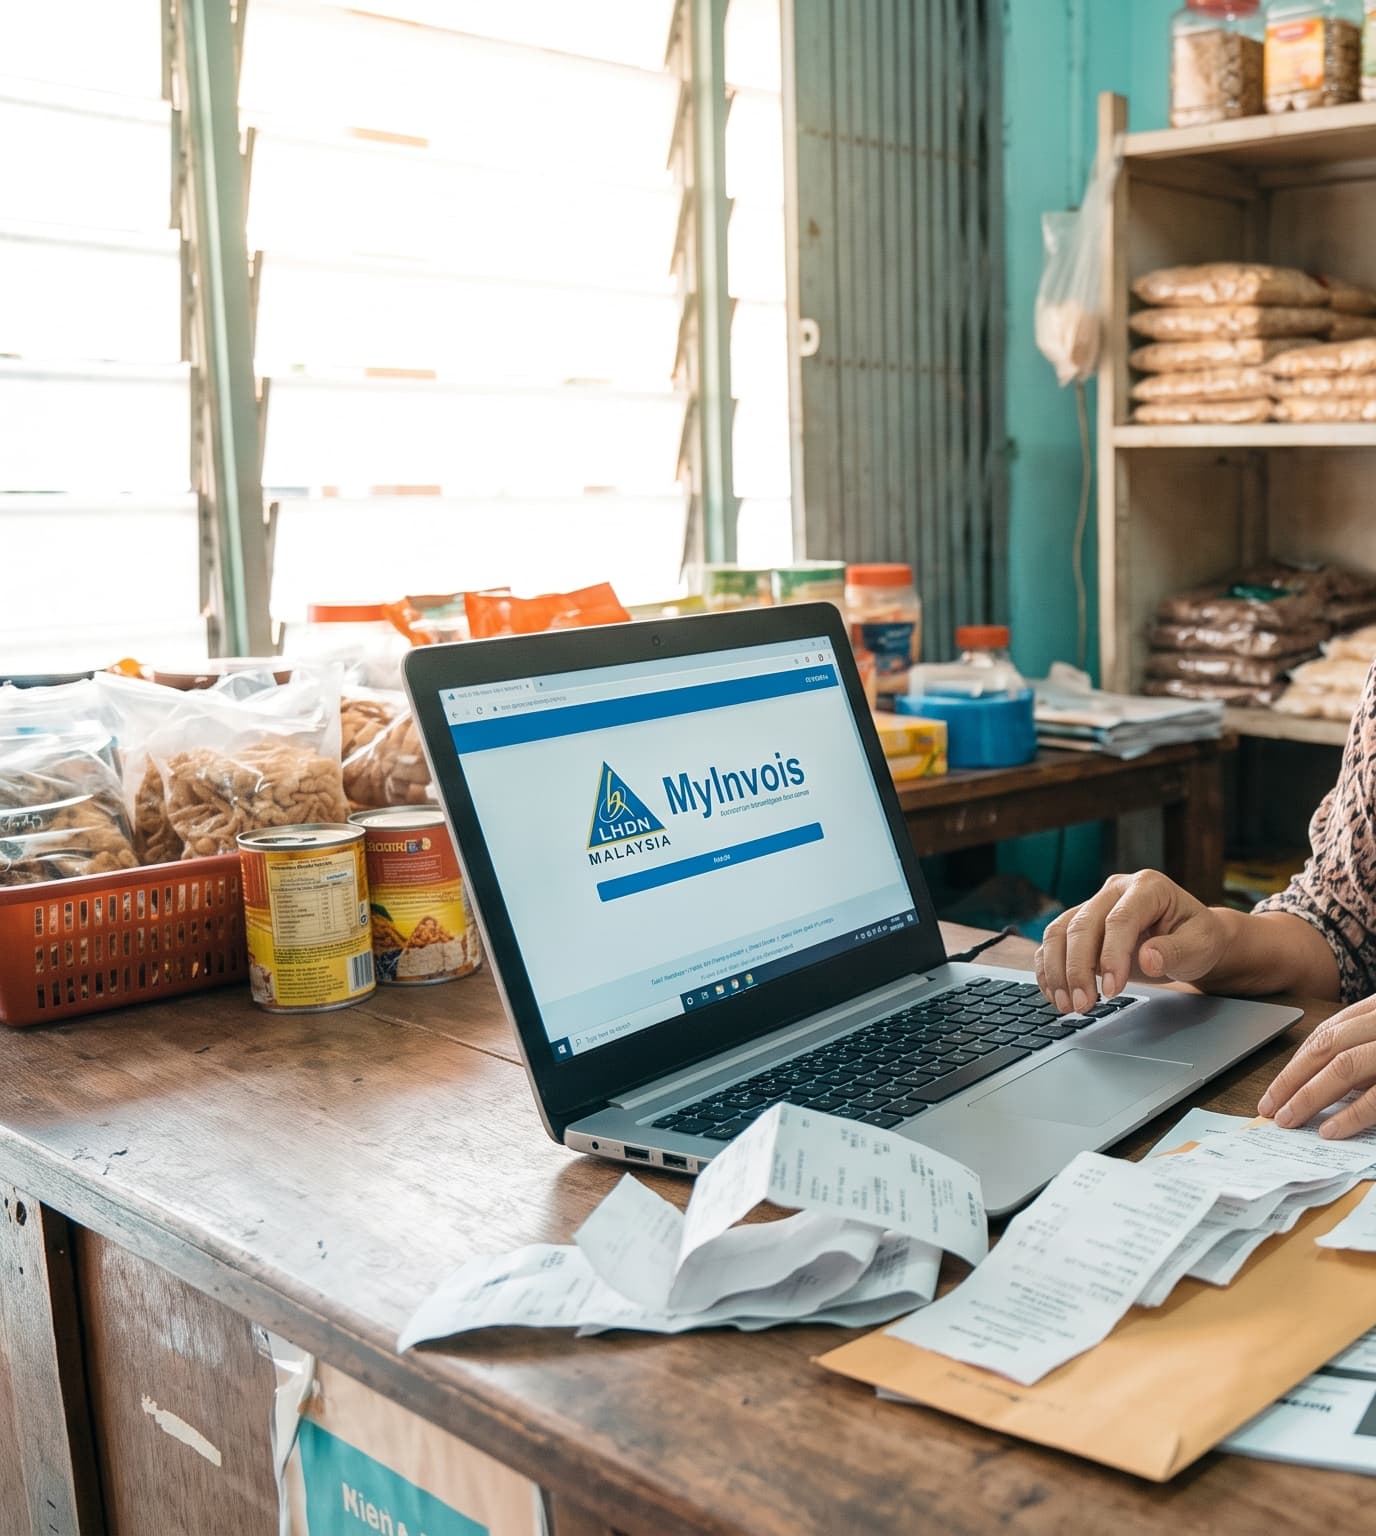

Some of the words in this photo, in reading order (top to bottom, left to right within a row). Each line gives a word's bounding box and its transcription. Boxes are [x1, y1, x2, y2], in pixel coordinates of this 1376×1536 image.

[662, 752, 805, 819] MyInvois
[598, 817, 651, 841] LHDN
[588, 834, 671, 866] MALAYSIA
